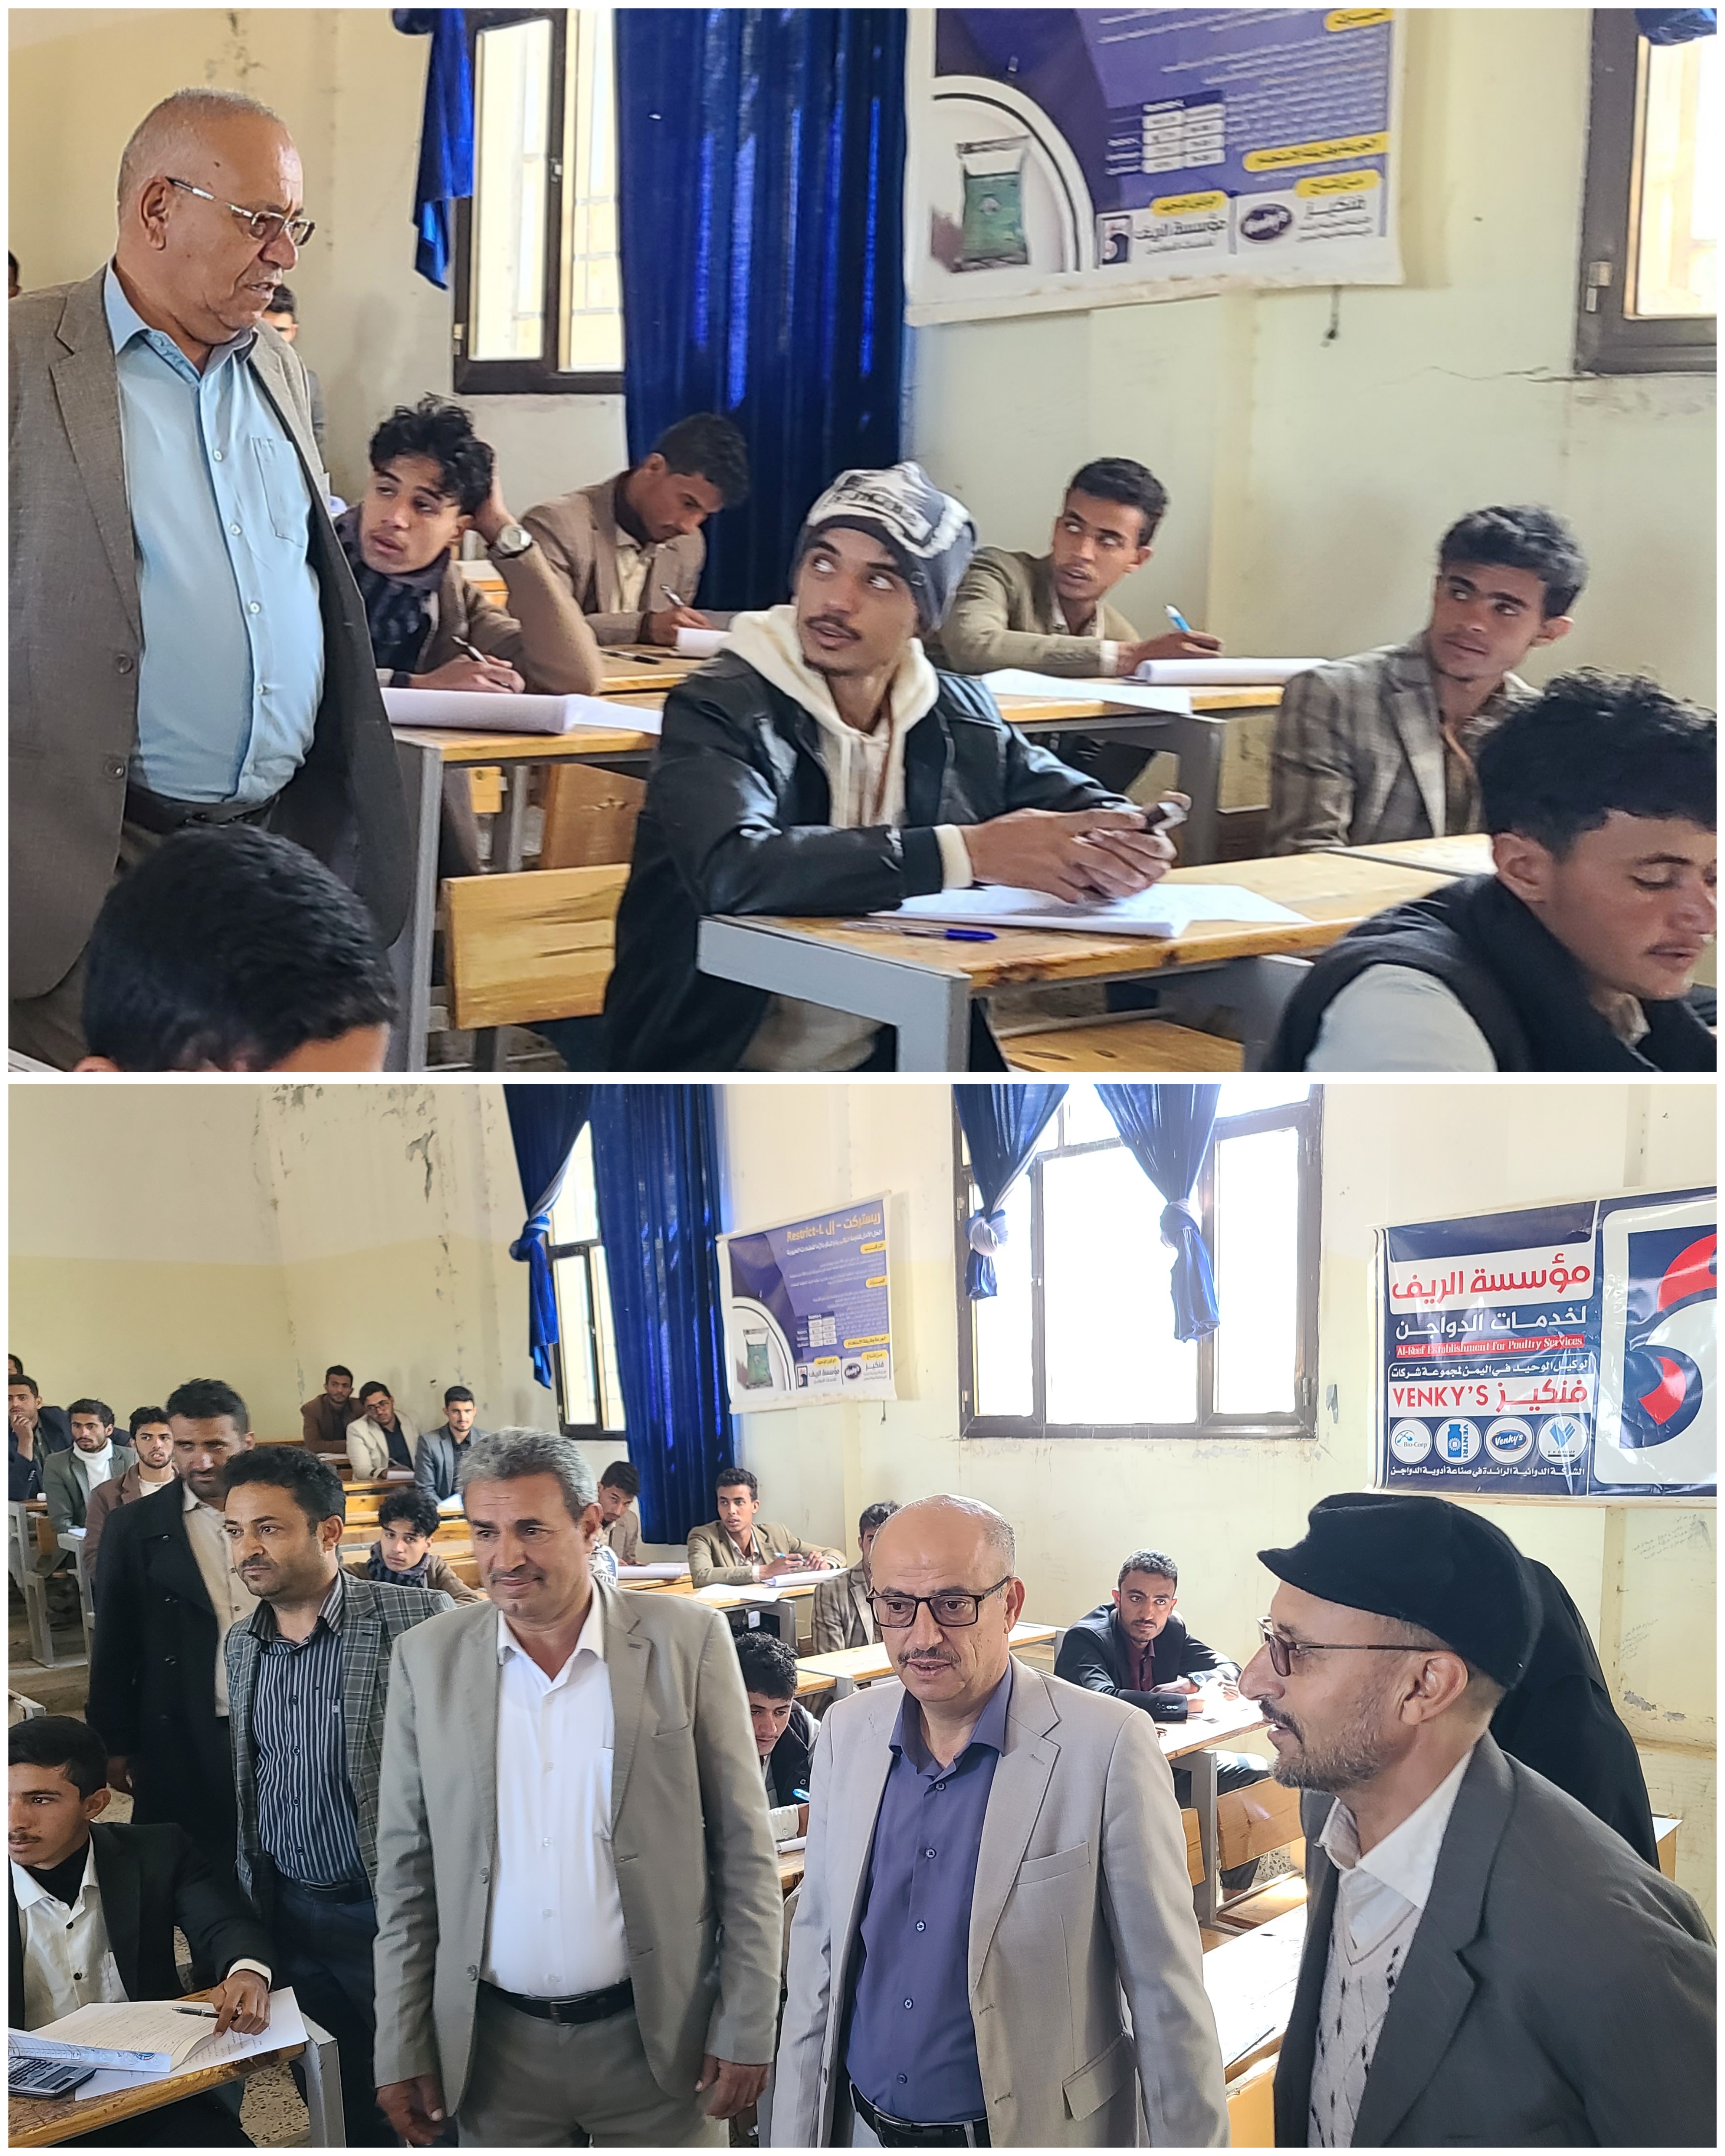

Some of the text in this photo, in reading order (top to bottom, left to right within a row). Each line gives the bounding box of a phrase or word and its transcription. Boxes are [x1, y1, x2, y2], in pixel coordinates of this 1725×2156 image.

[787, 1224, 824, 1242] Restrict-L
[1392, 1253, 1590, 1305] مؤسسة الريف
[1395, 1305, 1586, 1340] لخدمات الدواجن
[1397, 1336, 1582, 1356] Al-Reef Establishment for Poultry Services
[1391, 1359, 1591, 1379] الوكيل الوحيد في اليمن لمجموعة شركات
[1392, 1378, 1587, 1413] فنكيز VENKY'S
[1495, 1433, 1523, 1446] Venky's
[1391, 1466, 1422, 1476] الدواجن
[1446, 1466, 1472, 1475] صناعة
[1472, 1466, 1481, 1477] في
[1551, 1467, 1585, 1477] الشركة
